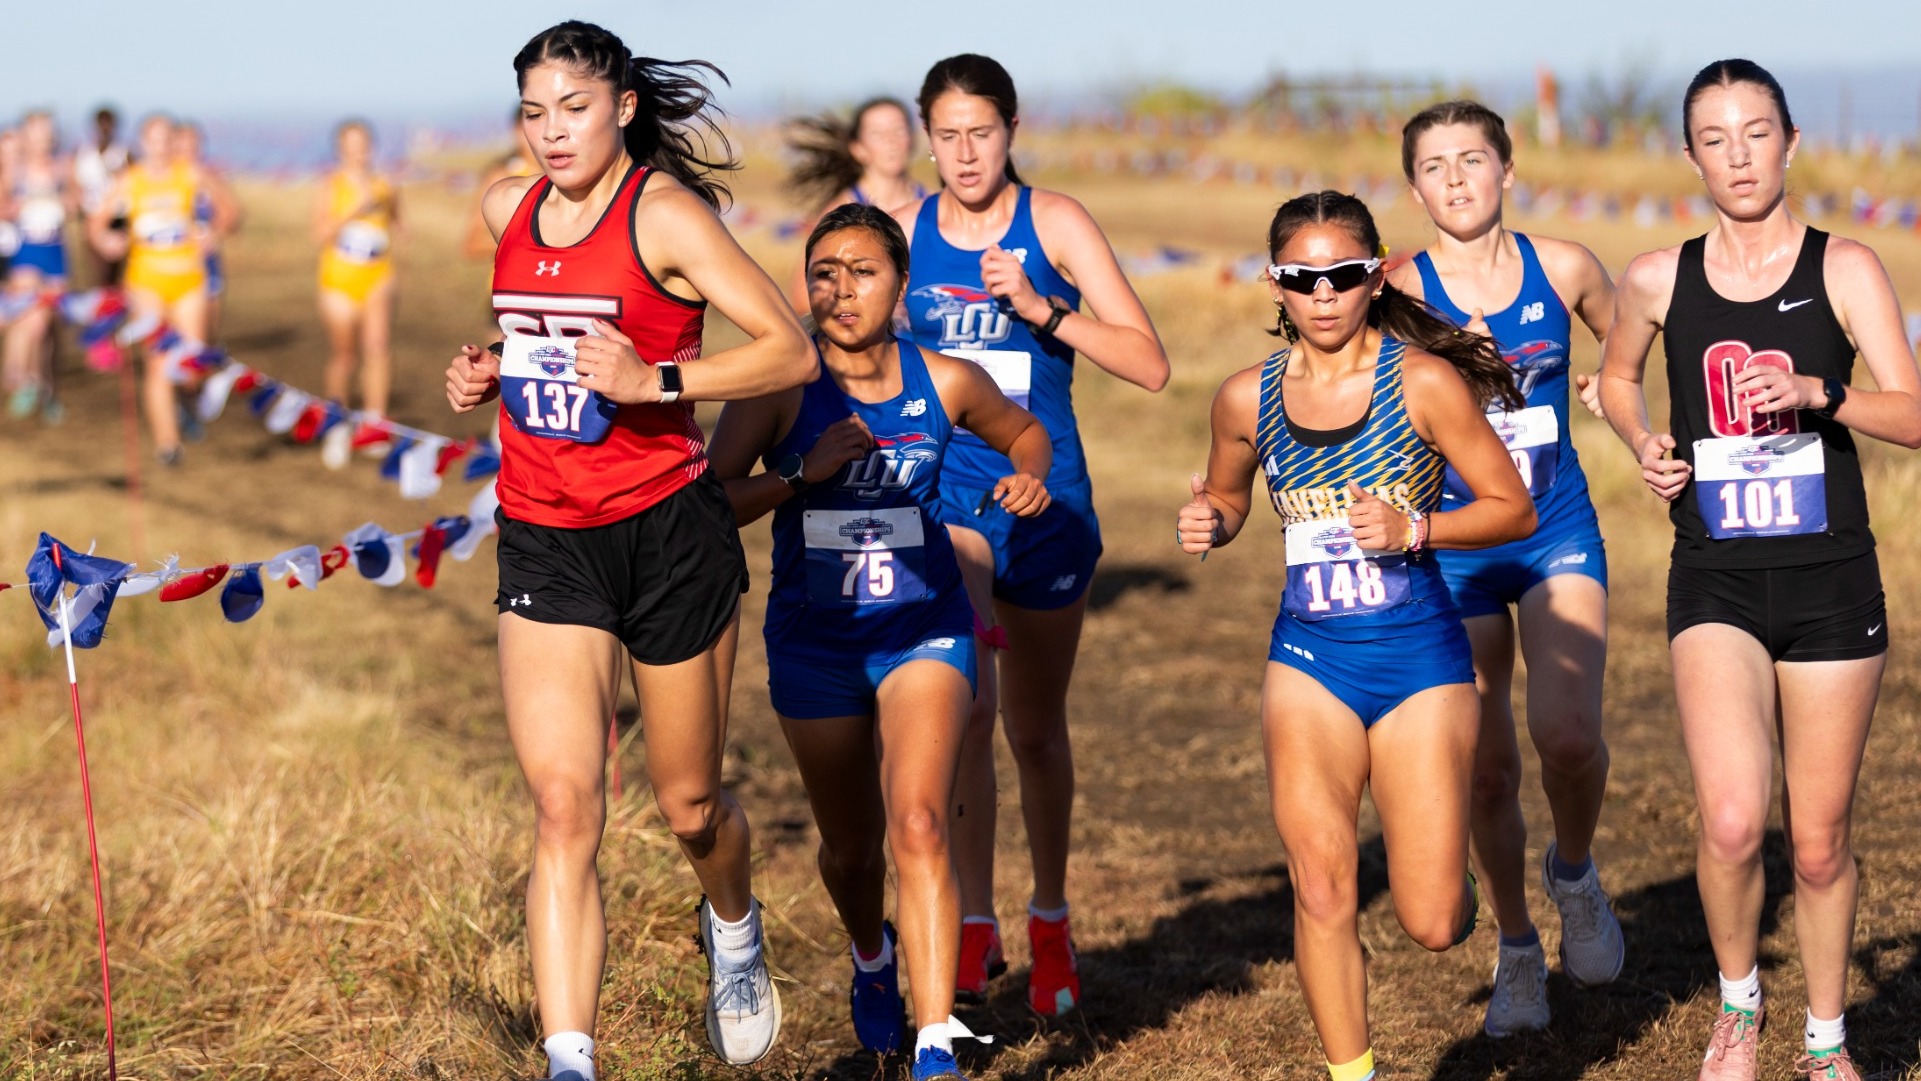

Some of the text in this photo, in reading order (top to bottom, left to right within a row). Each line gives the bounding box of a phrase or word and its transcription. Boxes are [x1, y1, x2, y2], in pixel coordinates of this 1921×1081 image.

[522, 381, 588, 432] 137
[1719, 478, 1800, 529] 101
[842, 551, 894, 597] 75
[1304, 561, 1386, 612] 148
